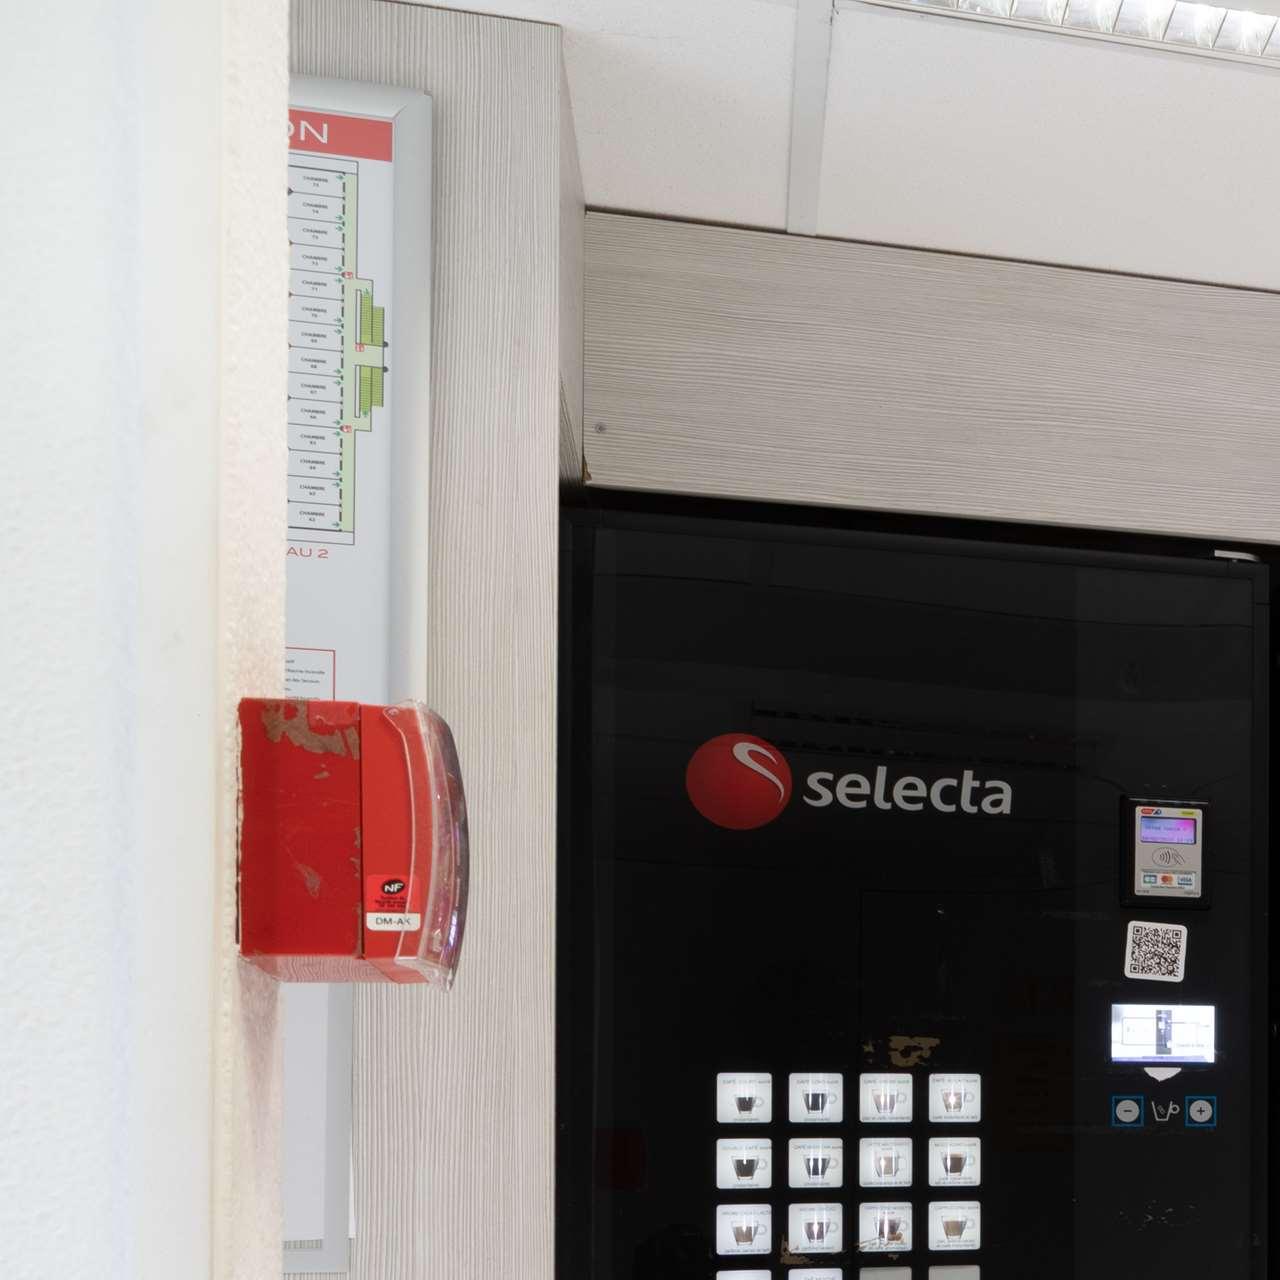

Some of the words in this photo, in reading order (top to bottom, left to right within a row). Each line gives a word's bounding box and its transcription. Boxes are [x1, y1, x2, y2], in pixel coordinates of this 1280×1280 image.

[317, 548, 328, 558] 2
[802, 766, 1012, 815] selecta
[384, 882, 404, 893] NF
